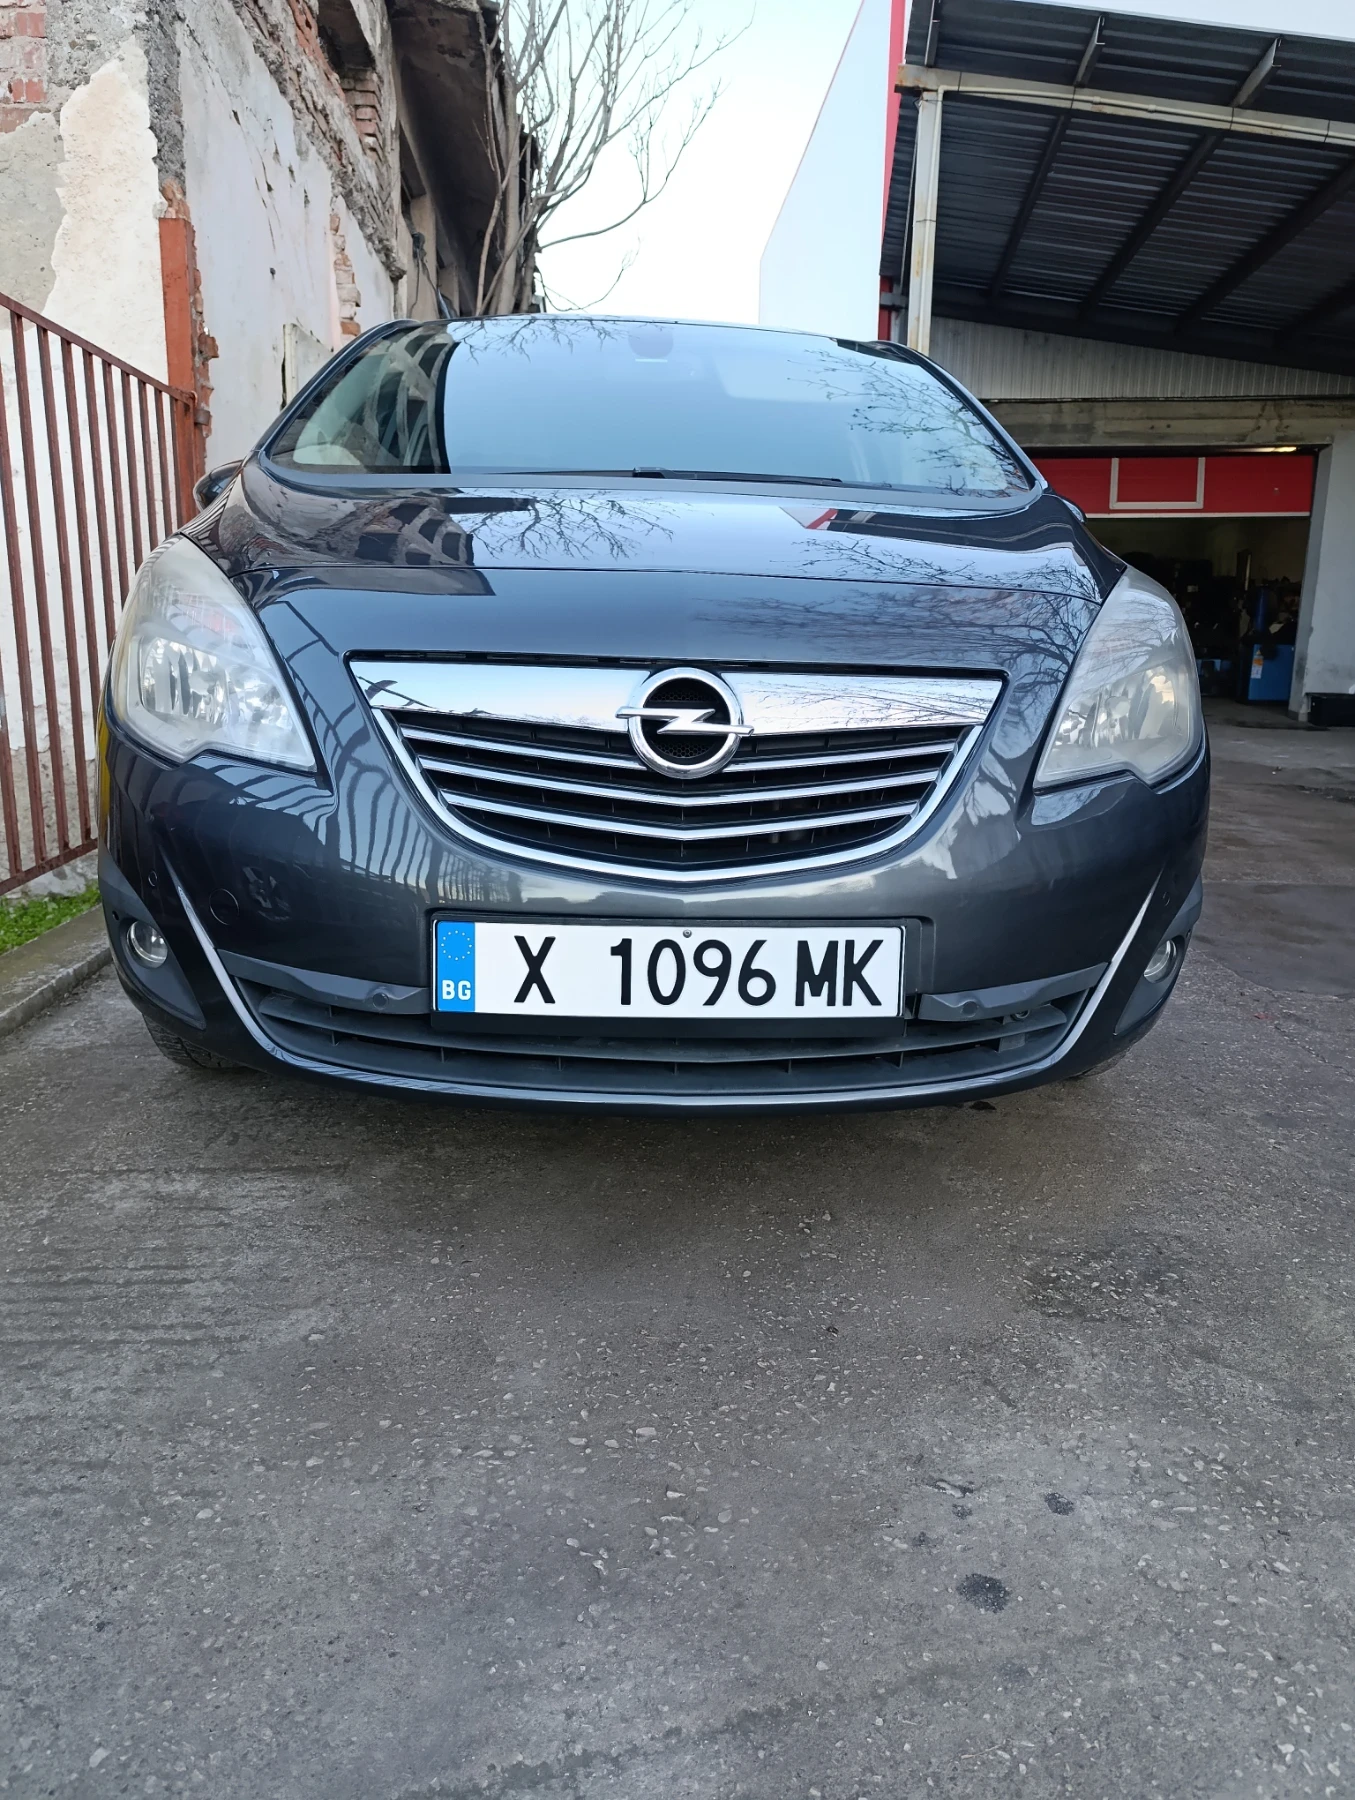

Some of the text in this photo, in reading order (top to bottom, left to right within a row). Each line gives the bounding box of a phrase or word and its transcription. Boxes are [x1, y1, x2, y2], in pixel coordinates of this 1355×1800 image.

[441, 979, 471, 1000] BG
[513, 935, 884, 1007] X 1096 MK
